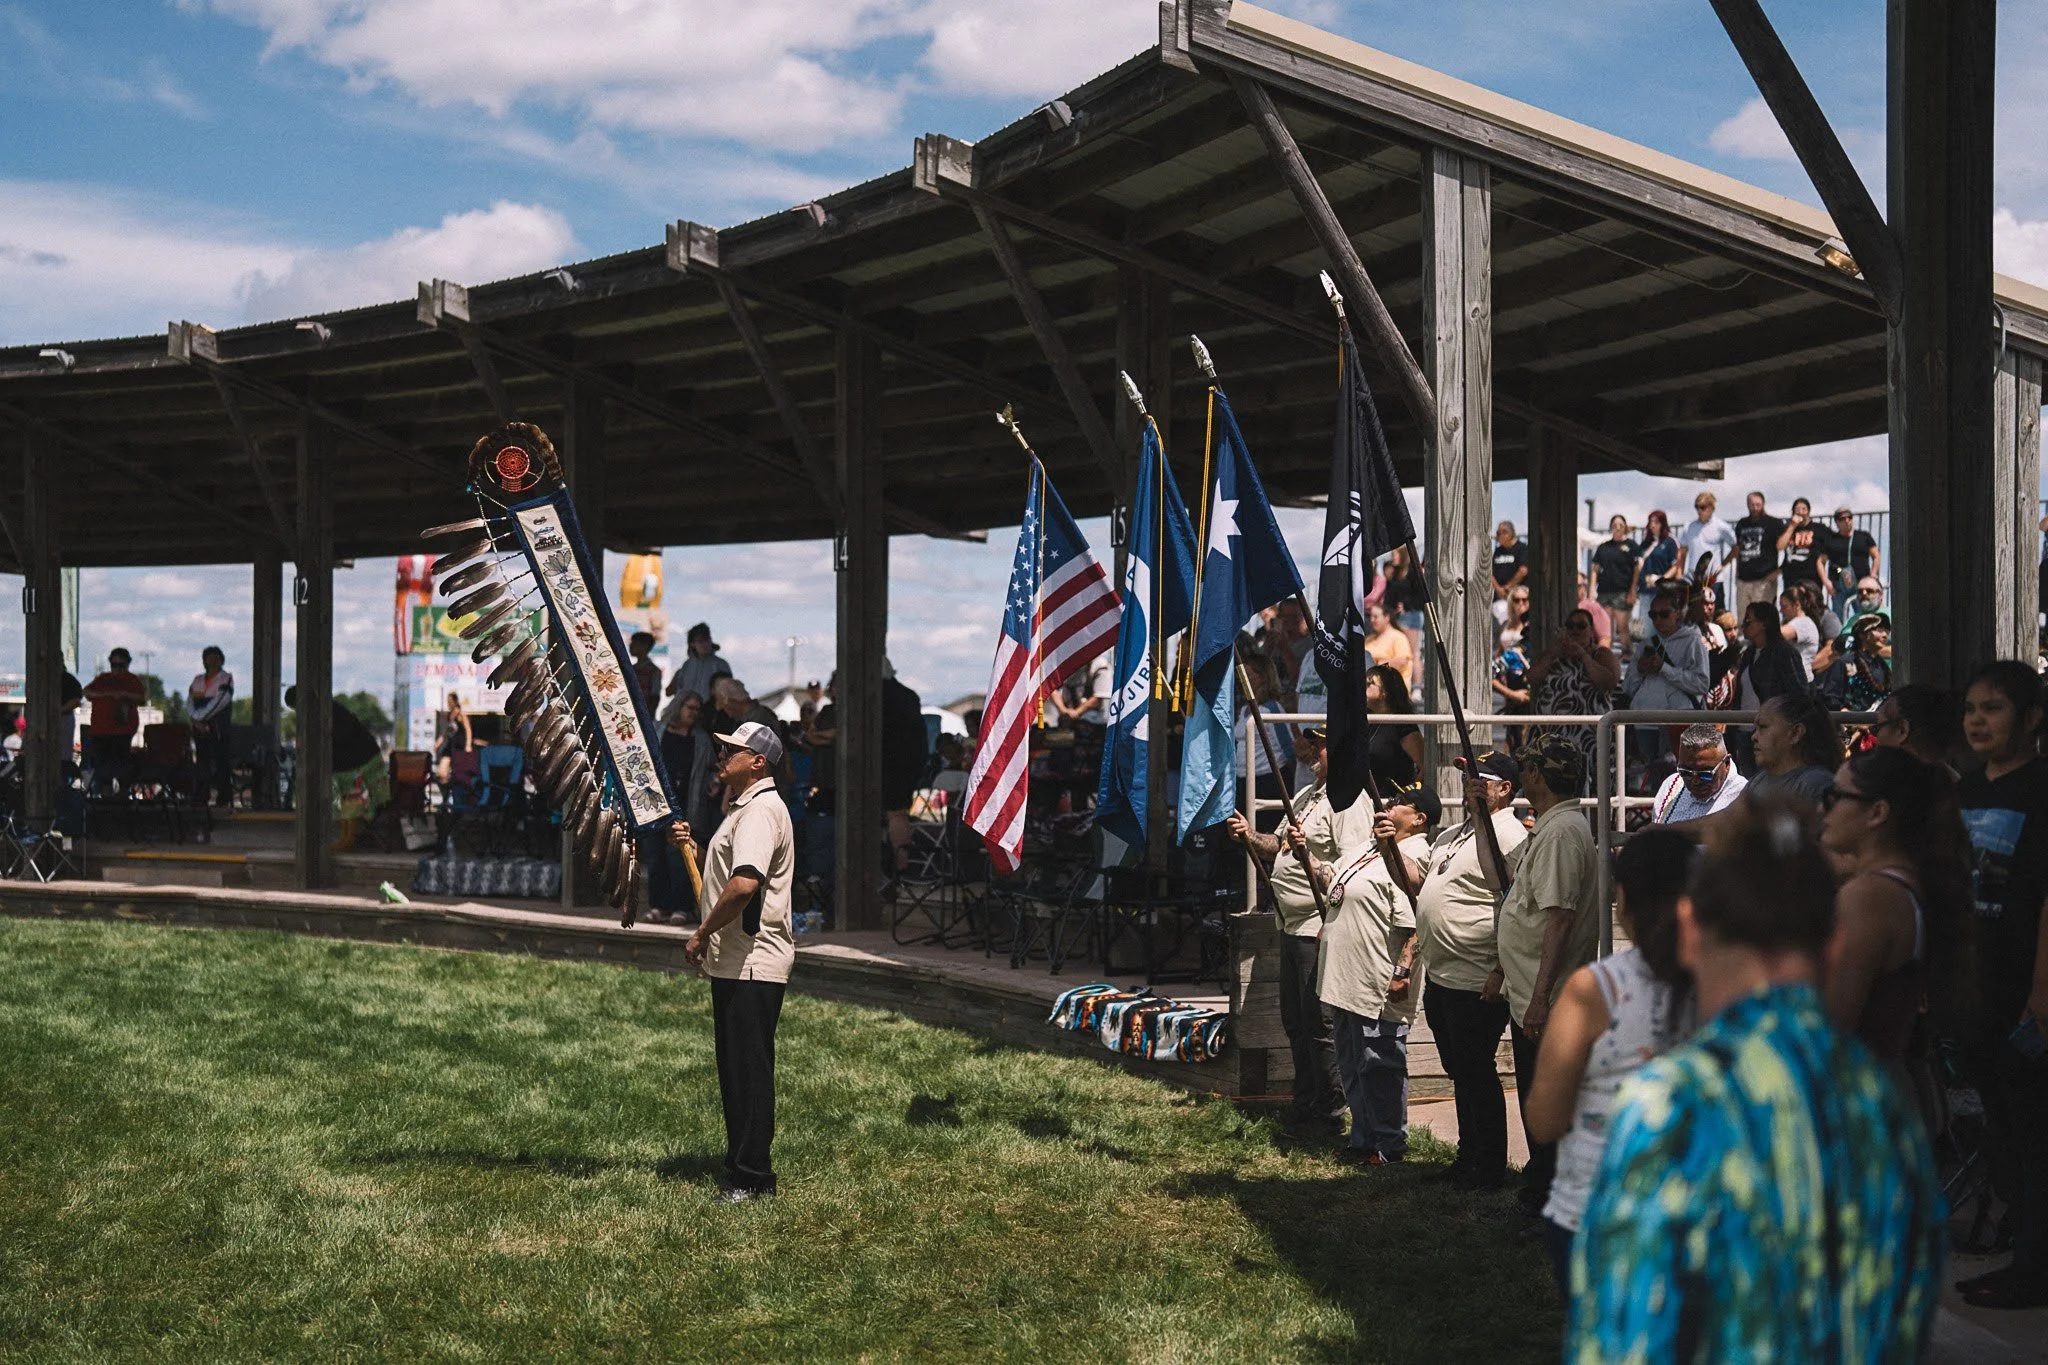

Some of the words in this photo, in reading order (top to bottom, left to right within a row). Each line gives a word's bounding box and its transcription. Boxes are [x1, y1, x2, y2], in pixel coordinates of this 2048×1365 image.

[1112, 506, 1126, 546] 15
[834, 536, 849, 570] 14
[24, 587, 36, 613] 11
[294, 577, 309, 605] 12
